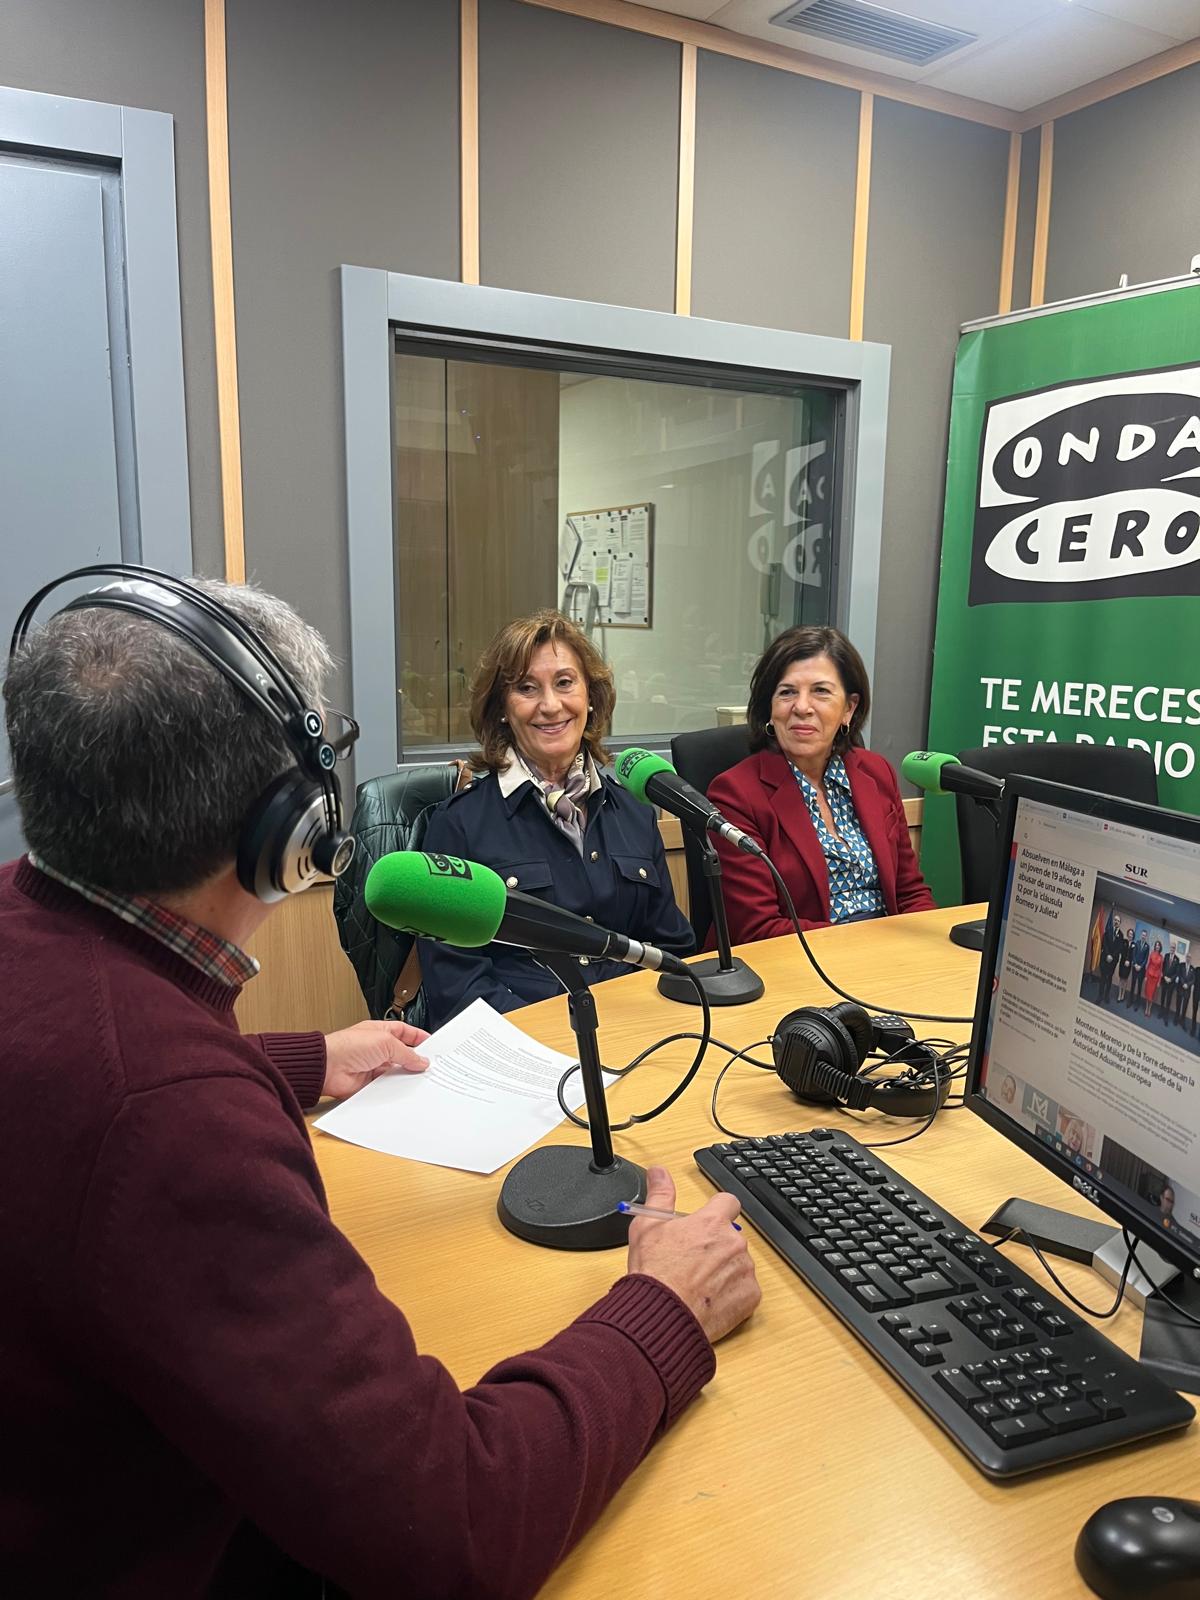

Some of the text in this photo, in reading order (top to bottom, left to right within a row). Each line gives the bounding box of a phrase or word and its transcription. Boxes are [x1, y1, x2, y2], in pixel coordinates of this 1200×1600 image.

[1013, 415, 1200, 478] ONDA
[1015, 509, 1200, 565] CERO
[980, 677, 1200, 726] TE MERECES
[1021, 848, 1050, 864] Absuelven
[1058, 860, 1080, 876] Málaga
[1026, 862, 1043, 875] joven
[1043, 868, 1051, 878] de
[1051, 871, 1059, 880] 19
[1073, 879, 1082, 889] de
[1124, 863, 1148, 878] SUR
[1015, 894, 1034, 909] Romeo
[1018, 873, 1085, 903] abusar de una menor de
[1022, 887, 1033, 897] por
[1072, 1038, 1152, 1088] Autoridad Aduanera Europea
[1073, 1028, 1182, 1092] solvencia de Málaga para ser sede de la
[1075, 1016, 1099, 1036] Montero,
[1099, 1029, 1122, 1047] Moreno
[1126, 1043, 1136, 1055] De
[1142, 1052, 1158, 1067] Torre
[1159, 1060, 1188, 1083] destacan
[1188, 1075, 1195, 1087] la
[1072, 1175, 1100, 1203] DELL
